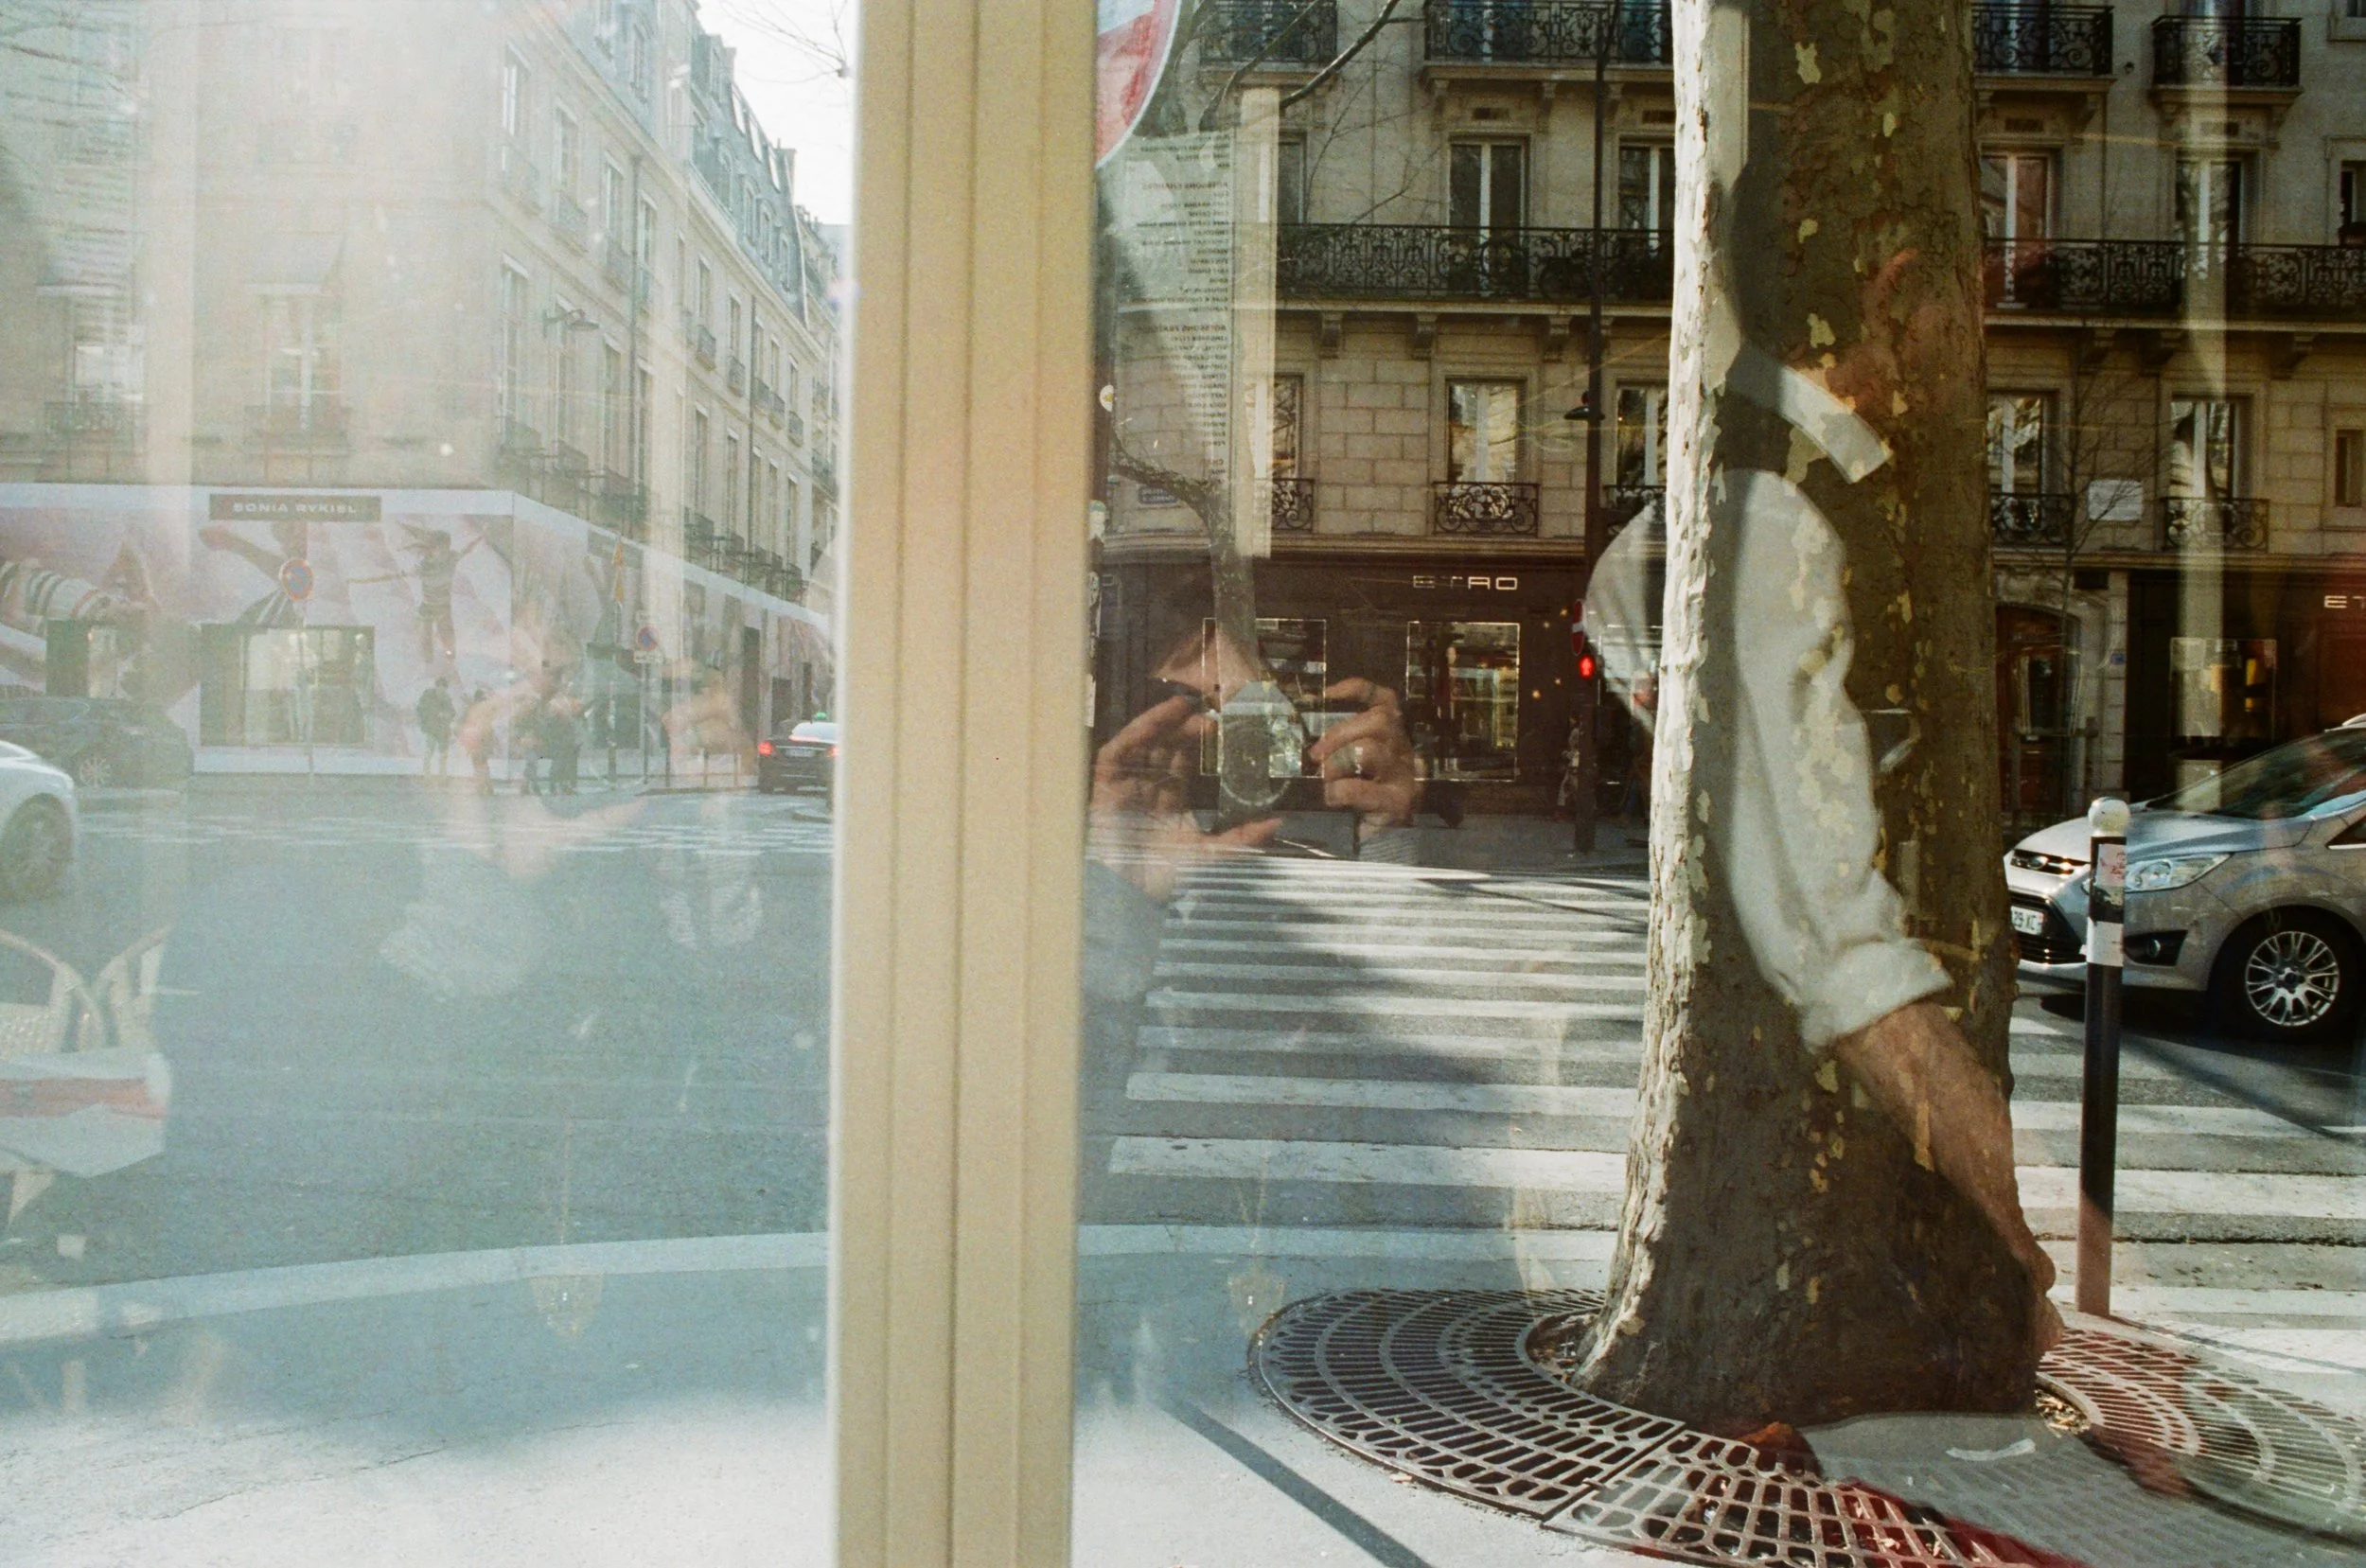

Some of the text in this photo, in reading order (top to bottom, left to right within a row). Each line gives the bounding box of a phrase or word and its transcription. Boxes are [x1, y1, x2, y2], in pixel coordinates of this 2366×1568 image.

[233, 502, 357, 514] SONIA RYKIEL
[1412, 575, 1518, 590] ETRO
